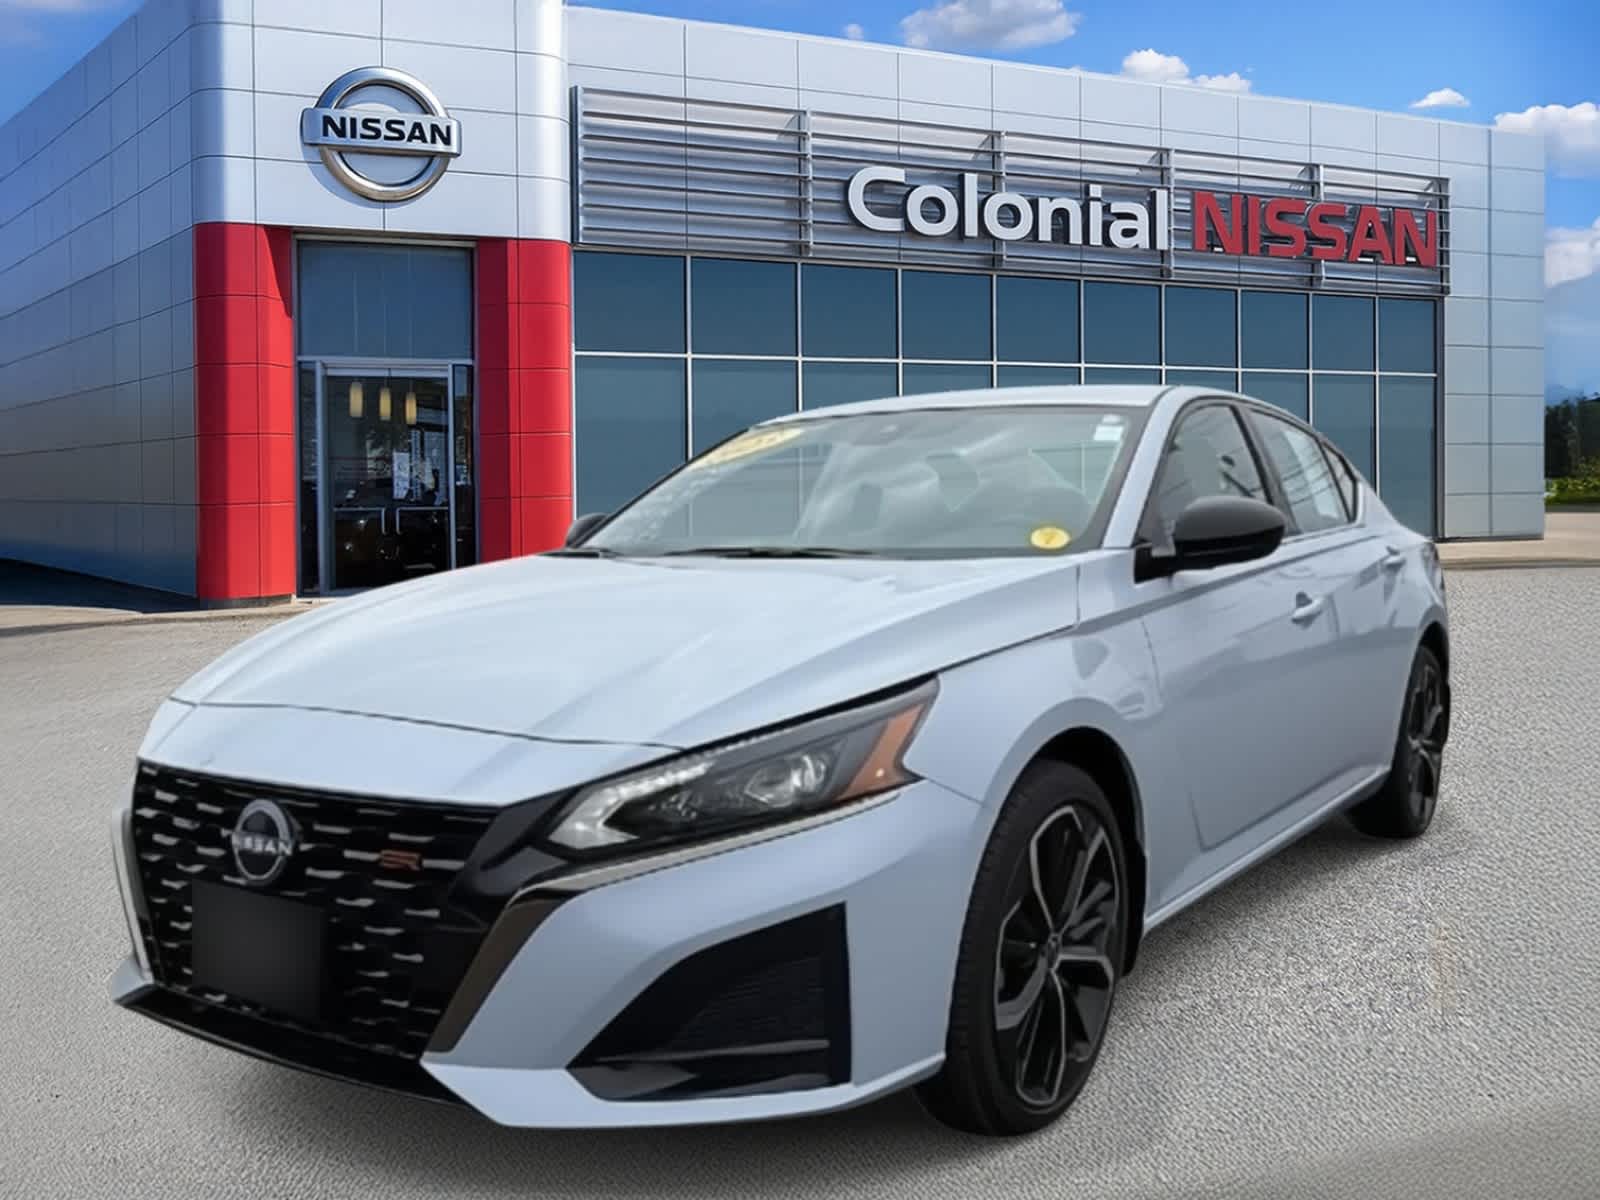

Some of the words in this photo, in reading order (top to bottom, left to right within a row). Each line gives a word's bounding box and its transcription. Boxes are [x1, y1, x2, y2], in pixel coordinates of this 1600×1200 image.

[322, 115, 452, 146] NISSAN
[848, 166, 1168, 250] Colonial
[1193, 191, 1437, 267] NISSAN
